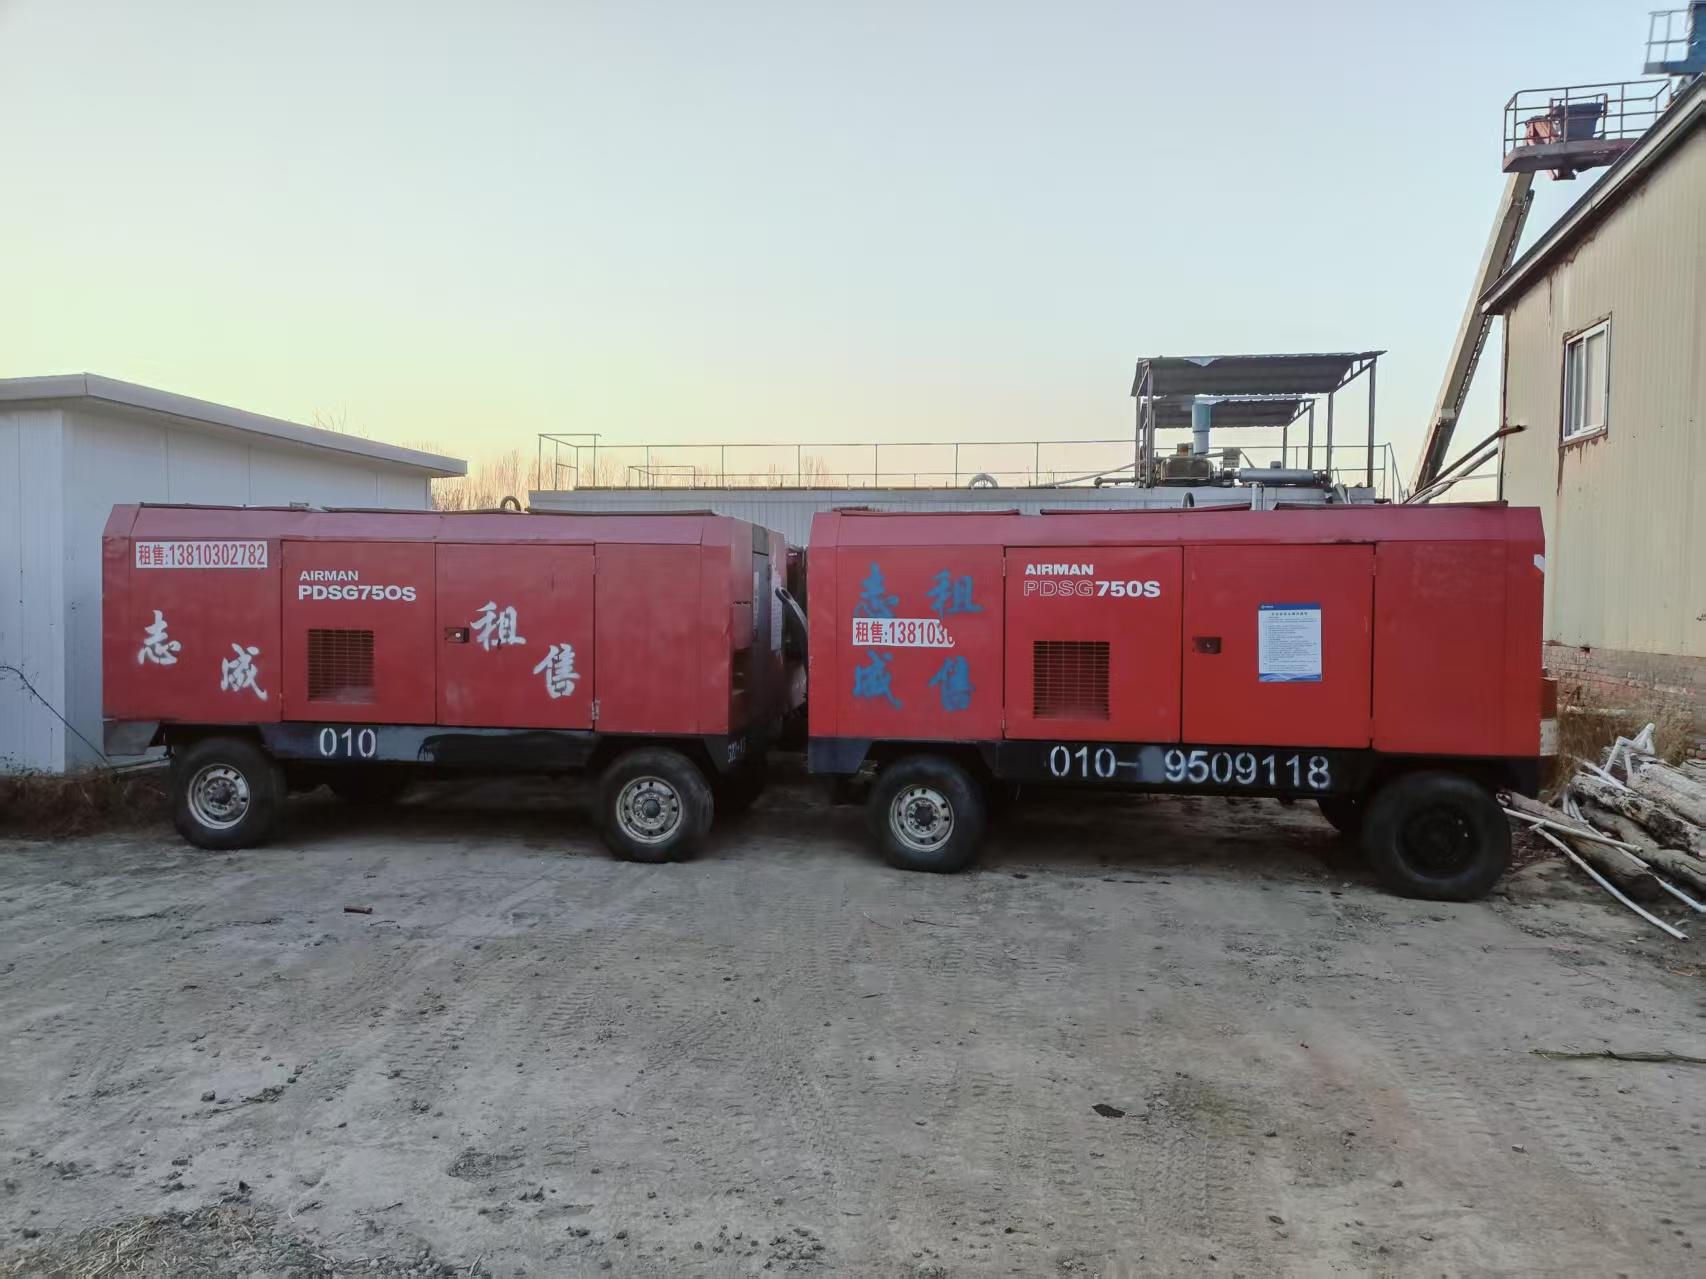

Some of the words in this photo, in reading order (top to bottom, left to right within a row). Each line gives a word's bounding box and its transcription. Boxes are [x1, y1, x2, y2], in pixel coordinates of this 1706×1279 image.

[138, 544, 265, 566] 租售:13810302782
[299, 570, 359, 582] AIRMAN
[1024, 563, 1094, 576] AIRMAN
[298, 584, 417, 602] PDSG750S
[1023, 579, 1161, 598] PDSG750S
[318, 727, 377, 759] 010
